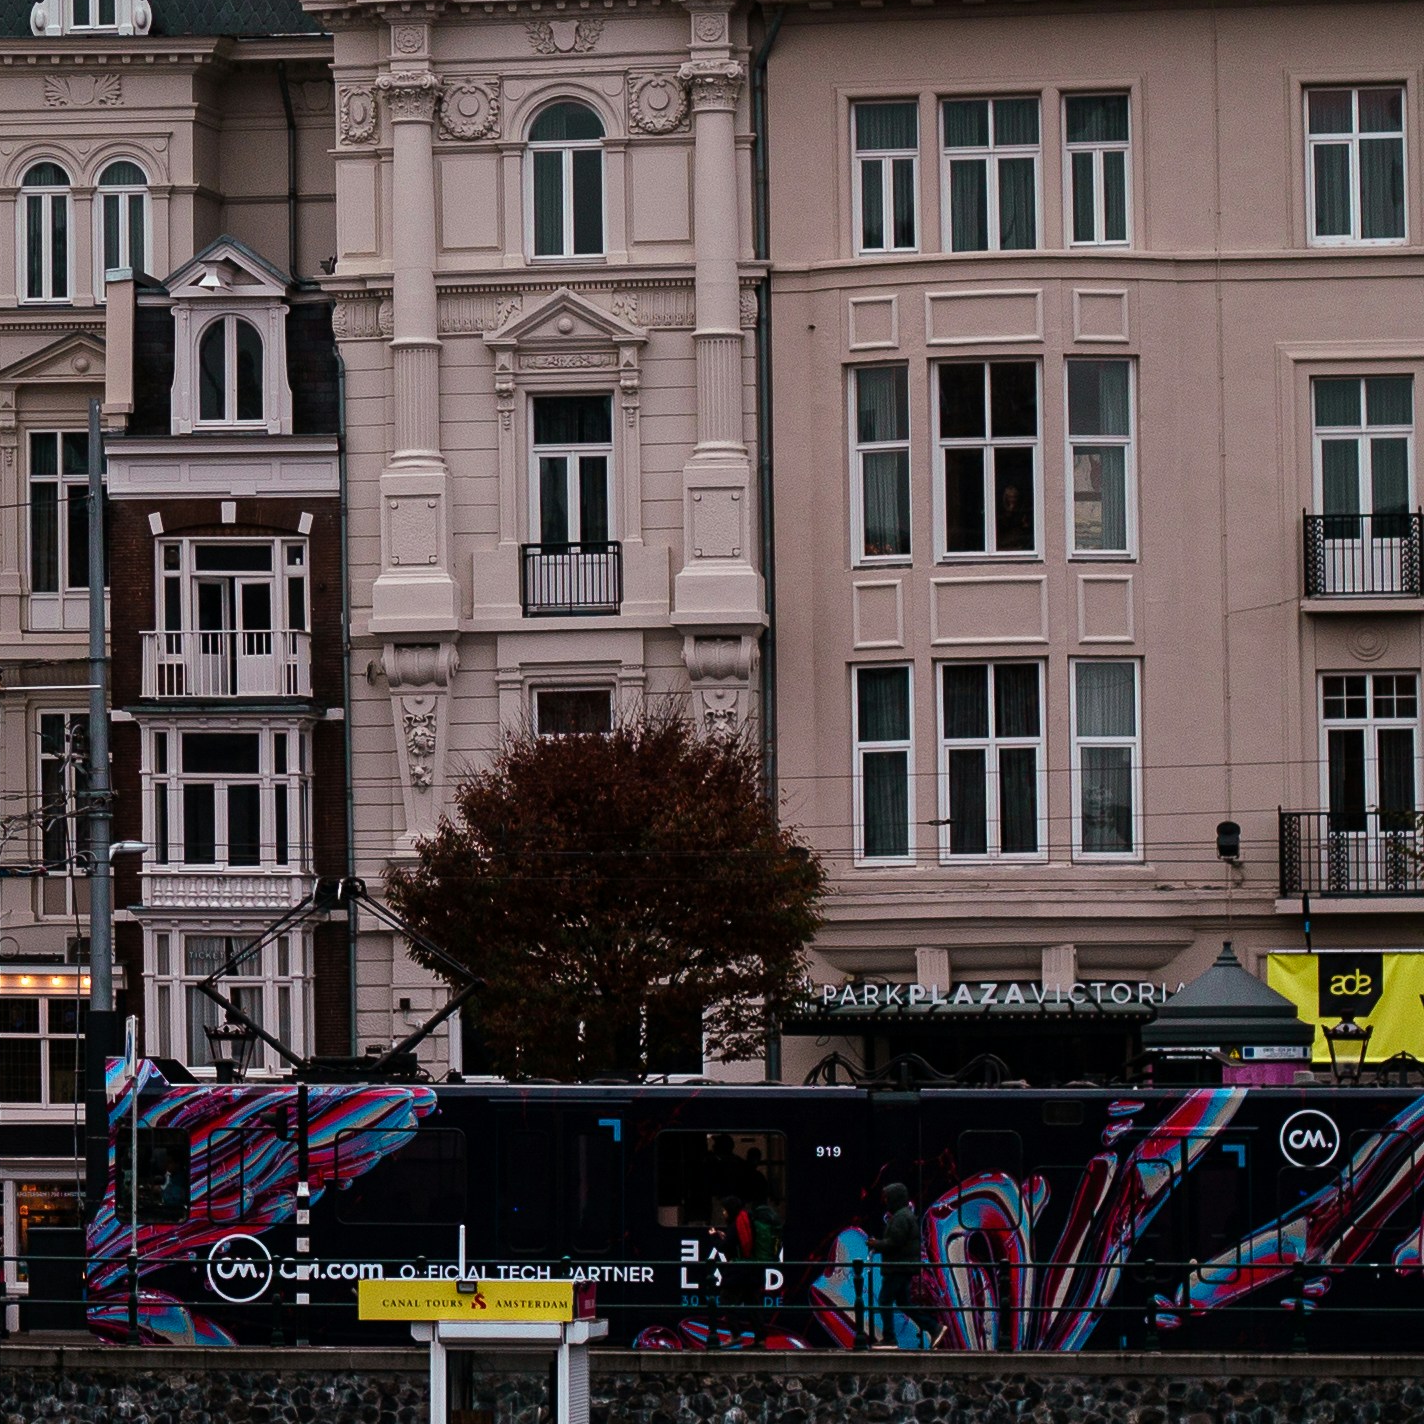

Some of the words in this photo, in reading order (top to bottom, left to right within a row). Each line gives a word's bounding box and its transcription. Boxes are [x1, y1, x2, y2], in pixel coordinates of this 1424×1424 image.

[189, 951, 226, 960] TICKET
[815, 1145, 842, 1158] 919
[399, 1264, 487, 1280] OFICAL
[496, 1265, 549, 1281] TECH
[382, 1299, 420, 1308] CANAL
[426, 1299, 464, 1308] TOURS
[495, 1299, 568, 1309] AMSTERDAM
